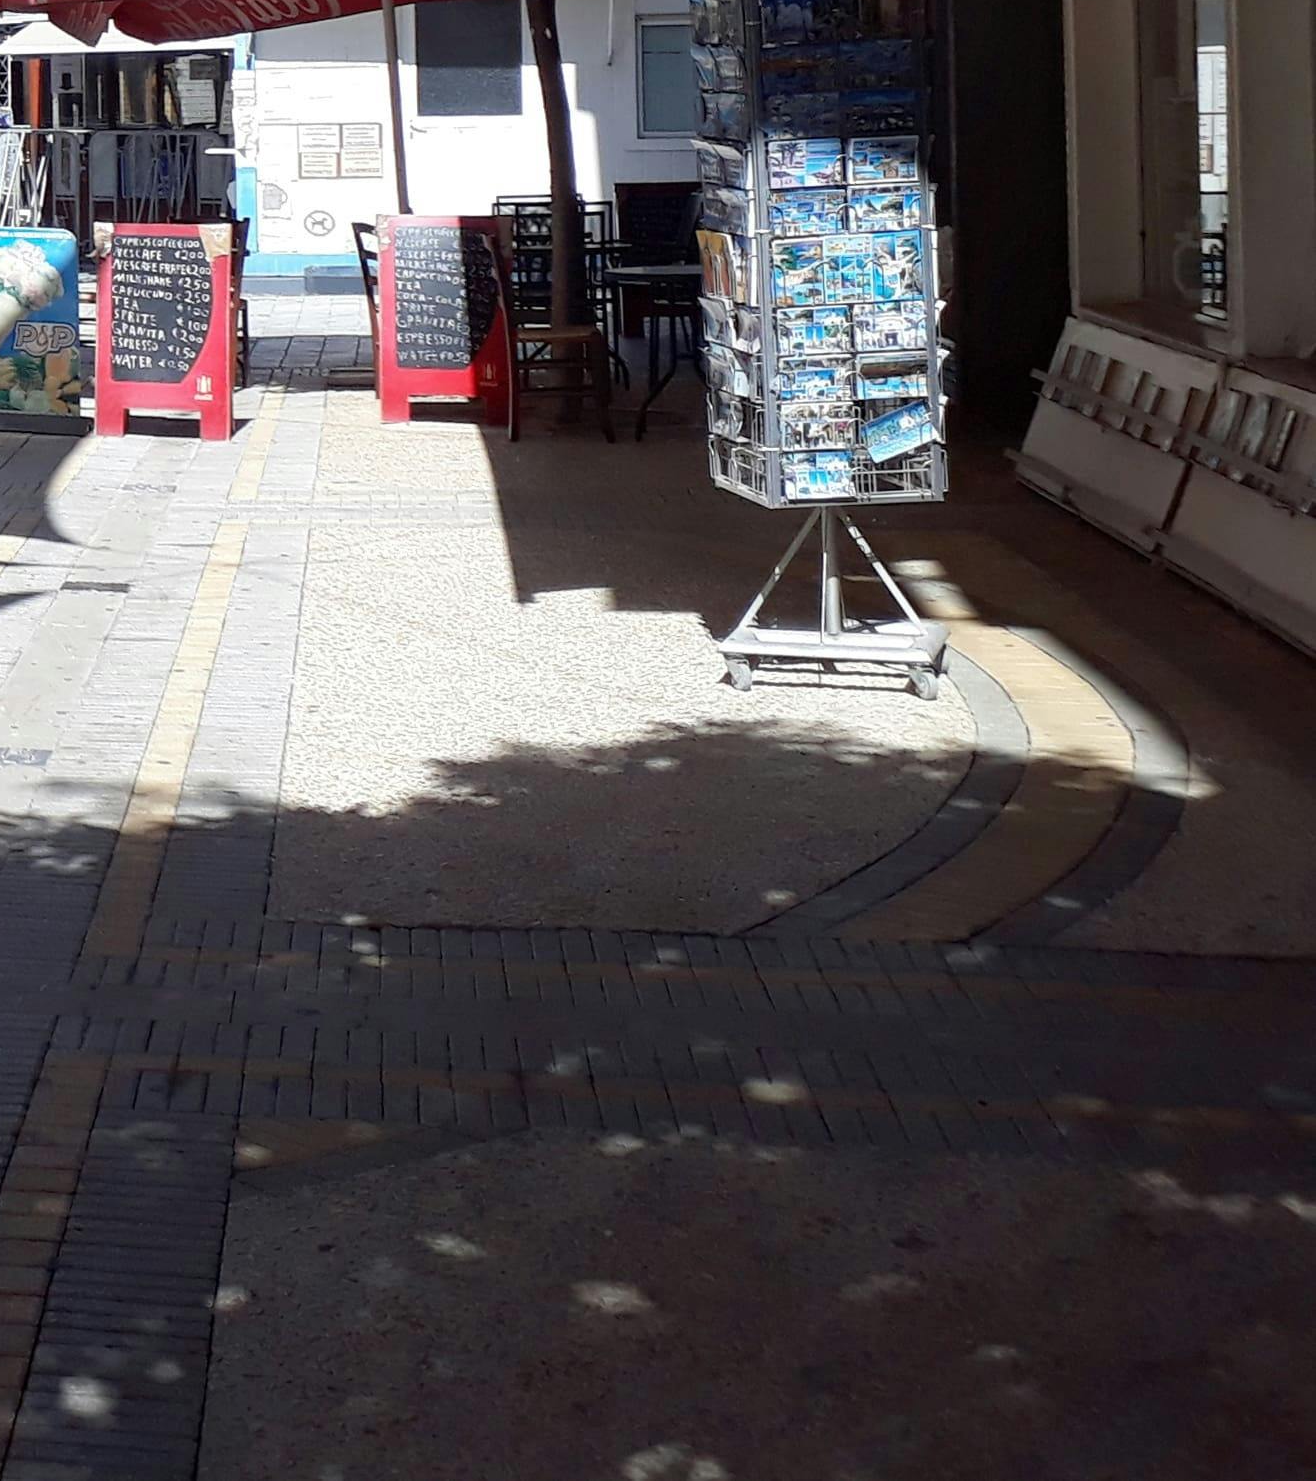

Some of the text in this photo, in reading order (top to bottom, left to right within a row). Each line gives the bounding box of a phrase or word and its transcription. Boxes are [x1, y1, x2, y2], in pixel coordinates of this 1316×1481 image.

[112, 295, 140, 310] TEA
[113, 308, 157, 327] SPRITE
[112, 335, 159, 352] ESPRESSO
[111, 354, 153, 370] WATER
